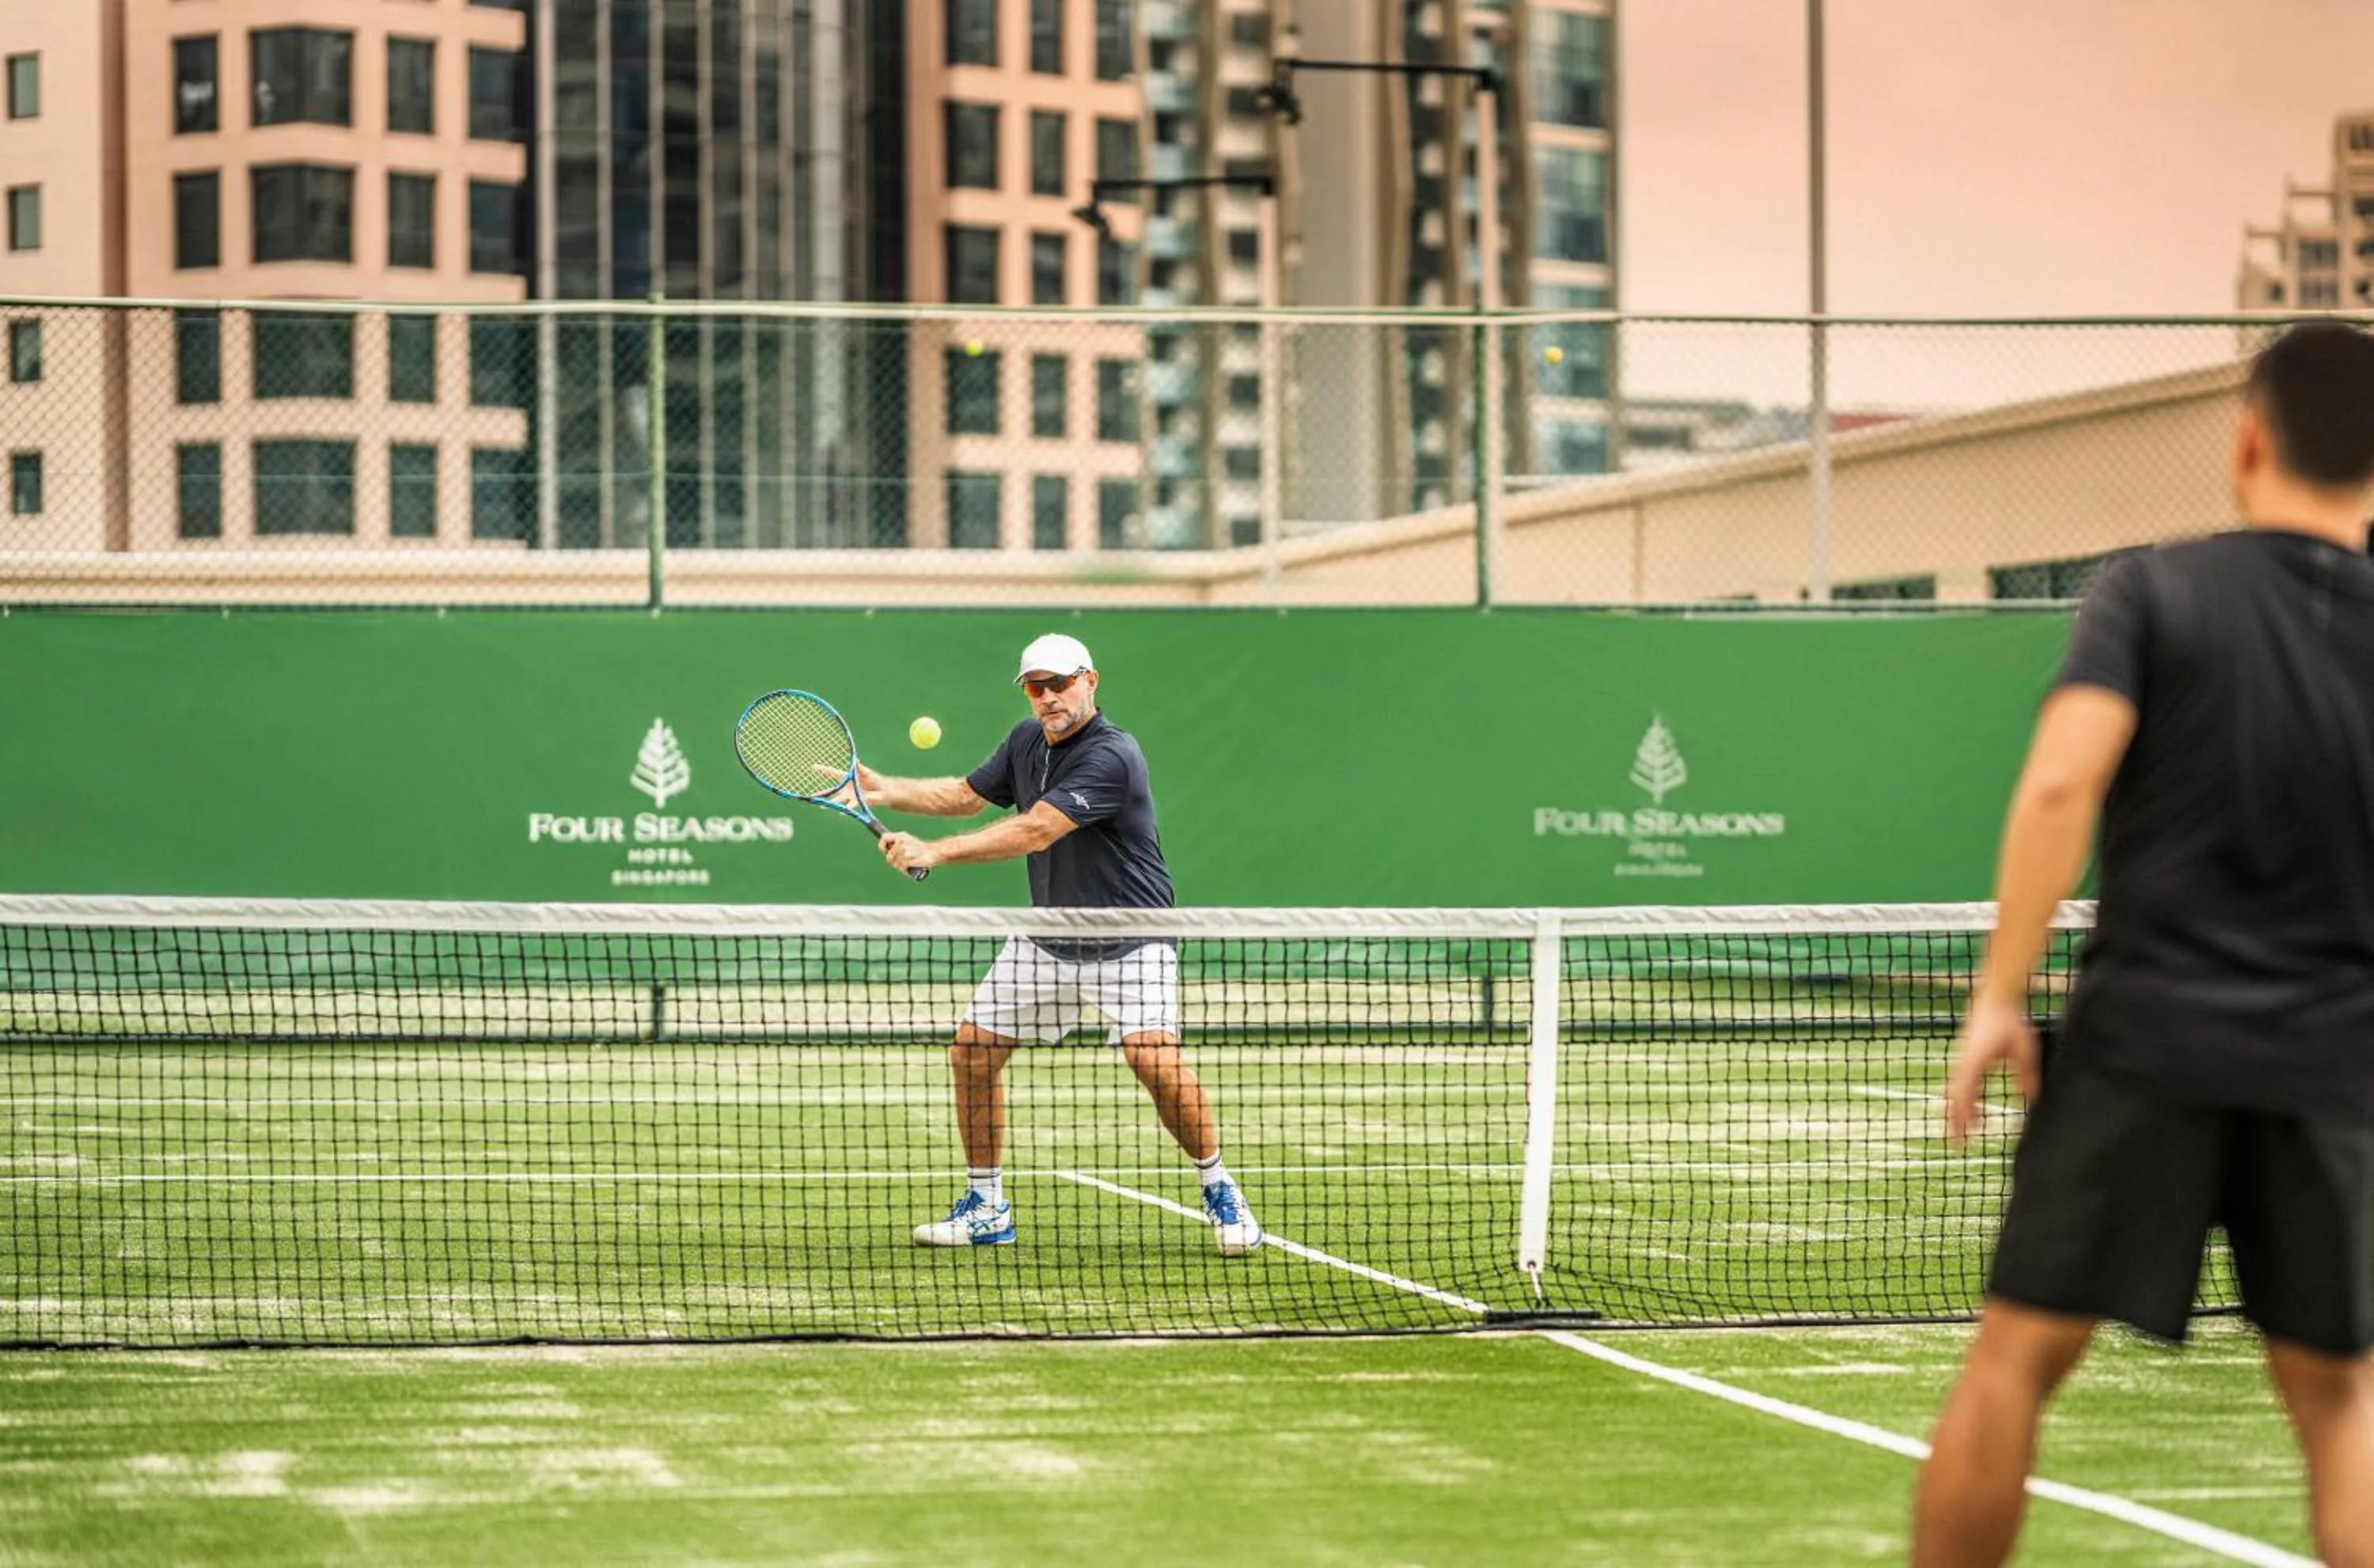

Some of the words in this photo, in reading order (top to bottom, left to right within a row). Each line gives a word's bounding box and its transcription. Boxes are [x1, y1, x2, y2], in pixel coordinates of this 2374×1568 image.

[529, 812, 624, 843] FOUR
[634, 812, 794, 842] SEASONS
[1534, 807, 1627, 836] FOUR
[1633, 808, 1785, 837] SEASONS
[628, 848, 693, 864] HOTEL
